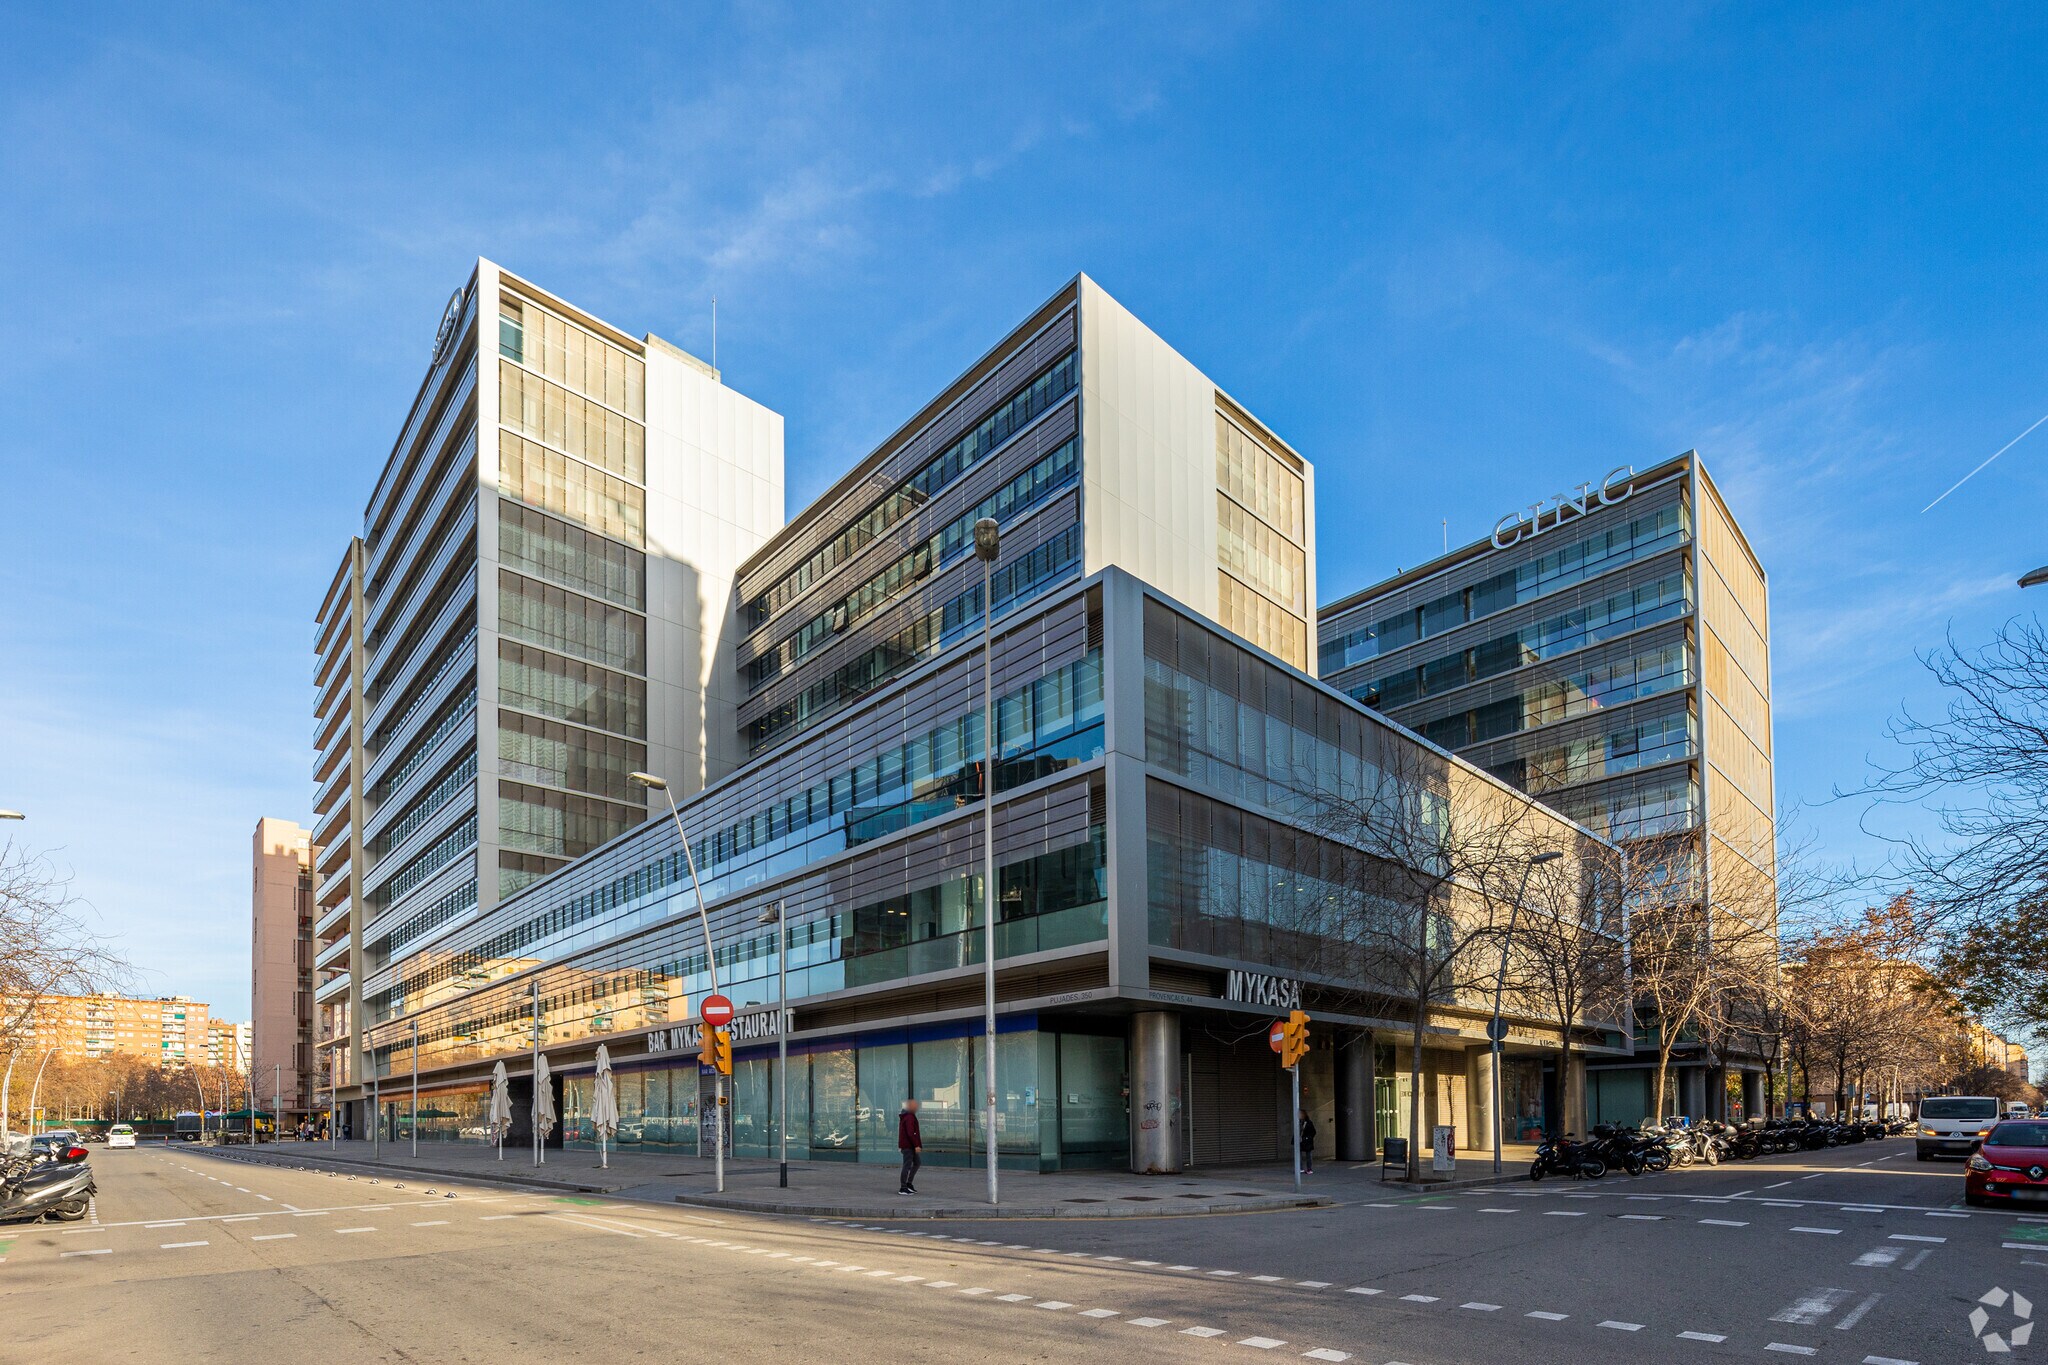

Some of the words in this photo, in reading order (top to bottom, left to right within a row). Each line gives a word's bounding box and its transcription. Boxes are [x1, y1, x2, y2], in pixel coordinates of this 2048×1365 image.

[1228, 970, 1301, 1010] MYKASA
[648, 1030, 666, 1053] BAR
[671, 1024, 704, 1050] MYKA
